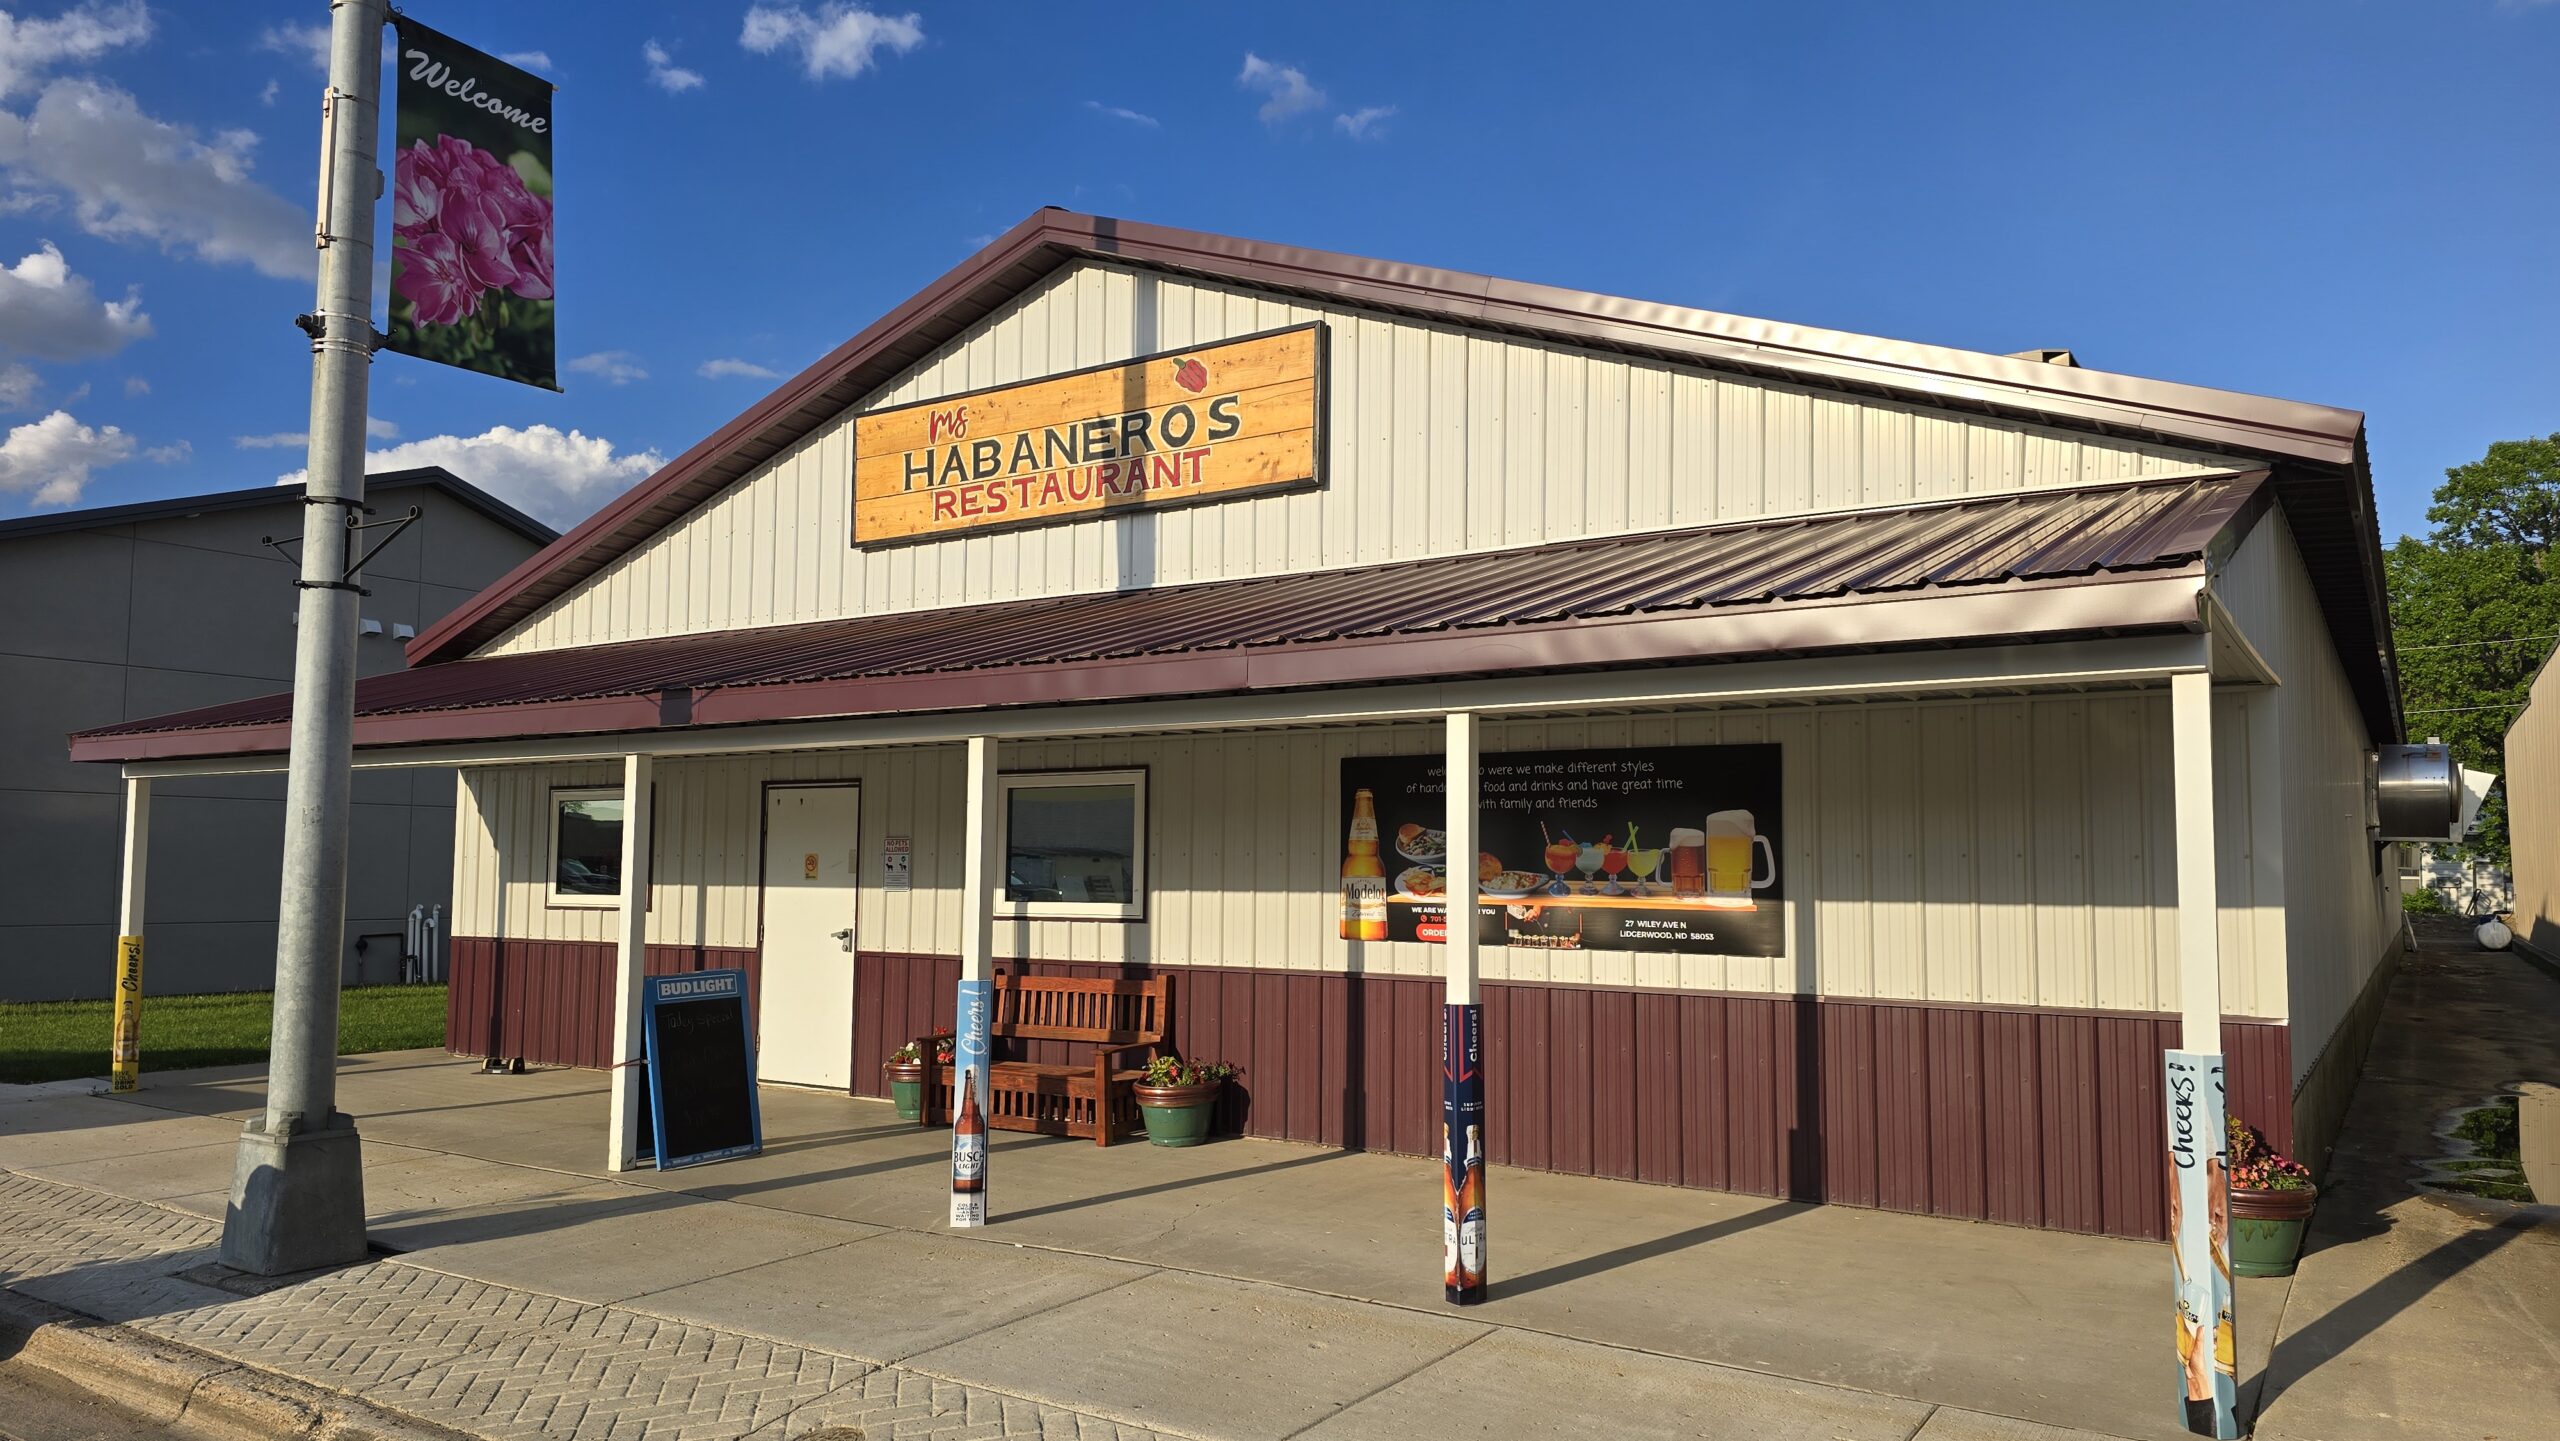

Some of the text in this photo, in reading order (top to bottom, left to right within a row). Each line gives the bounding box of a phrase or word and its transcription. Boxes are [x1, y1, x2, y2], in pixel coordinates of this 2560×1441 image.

[405, 48, 547, 133] Welcome
[934, 448, 1211, 521] RESTAURANT
[1488, 765, 1513, 775] were
[1516, 764, 1531, 775] we
[1534, 762, 1564, 773] make
[1567, 761, 1617, 773] different
[1621, 760, 1655, 777] styles
[1406, 782, 1417, 794] of
[1484, 781, 1505, 792] food
[1508, 780, 1527, 792] and
[1530, 779, 1563, 791] drinks
[1567, 779, 1588, 791] and
[1592, 778, 1618, 790] have
[1622, 778, 1653, 795] great
[1656, 778, 1684, 789] time
[1499, 797, 1532, 814] family
[1535, 797, 1555, 808] and
[1559, 796, 1598, 808] friends
[1345, 883, 1381, 900] Modelo
[1625, 919, 1688, 929] 27 WILEY AVE N
[1620, 930, 1674, 940] LIDGERWOOD,
[1690, 932, 1715, 941] 58053
[121, 941, 141, 992] Cheers!
[661, 978, 734, 996] BUD LIGHT
[961, 988, 986, 1057] Cheers!
[1469, 1009, 1478, 1062] Cheers!
[954, 1150, 985, 1163] BUSCH
[958, 1162, 979, 1170] LIGHT
